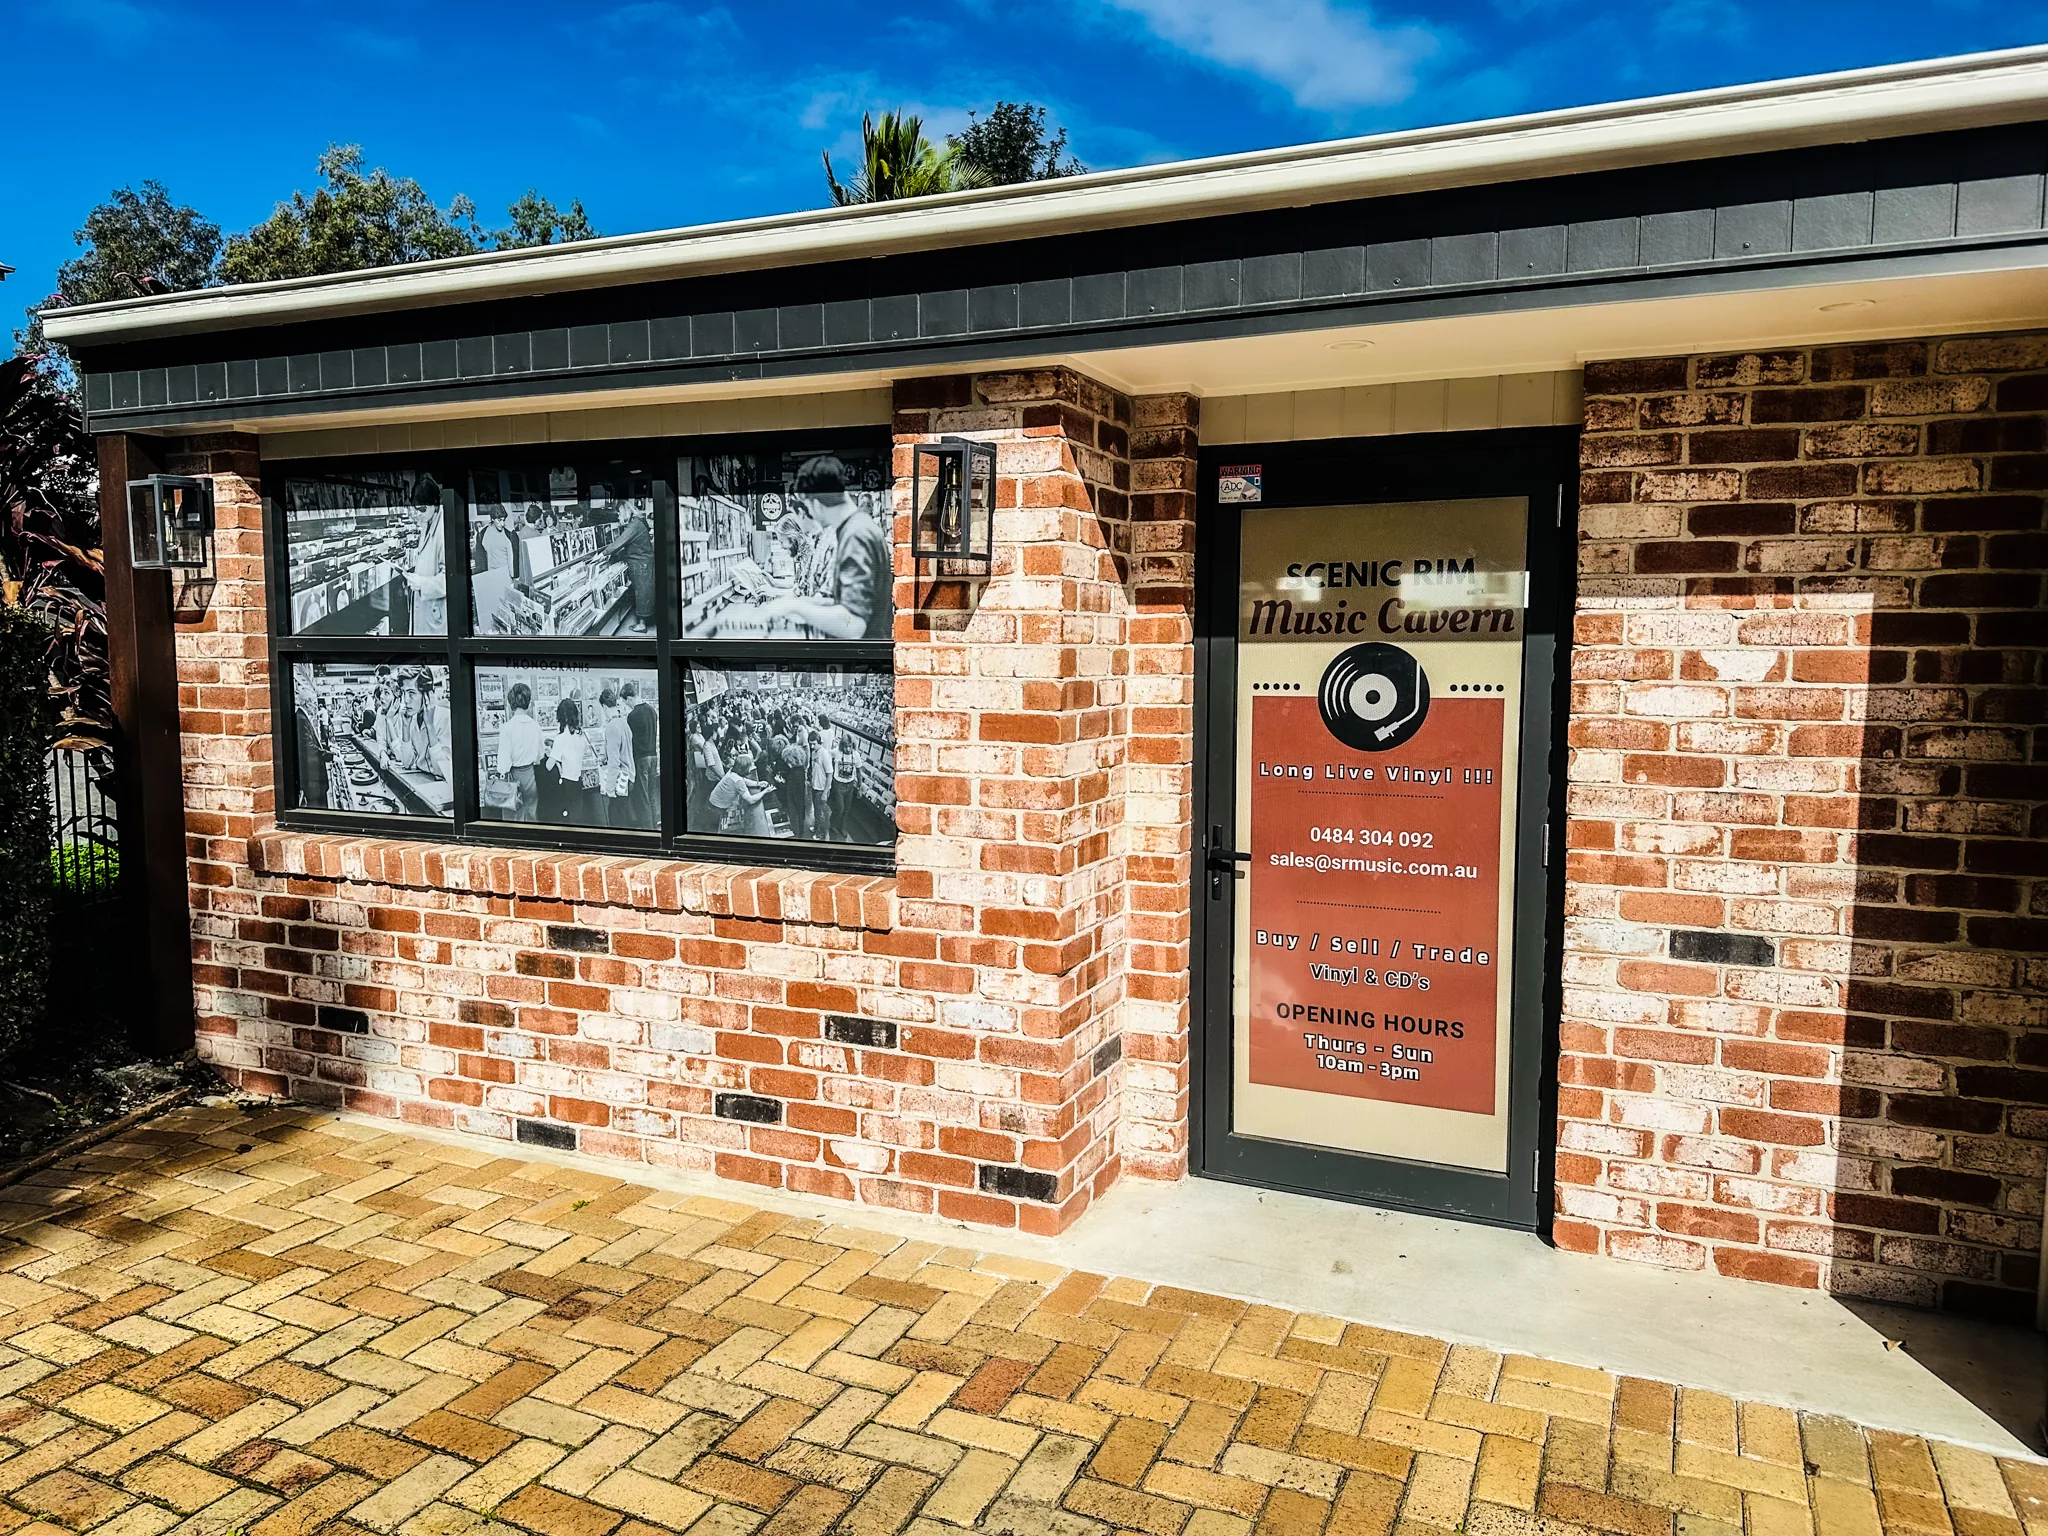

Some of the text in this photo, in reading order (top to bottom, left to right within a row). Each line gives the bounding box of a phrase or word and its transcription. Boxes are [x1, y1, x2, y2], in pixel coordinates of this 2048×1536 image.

[1221, 465, 1261, 476] WARNING
[1287, 558, 1476, 589] SCENIC RIM
[1249, 597, 1515, 635] Music Cavern
[505, 658, 590, 673] PHONOGRAPHS
[1259, 762, 1493, 785] Long Live Vinyl !!!
[1310, 827, 1434, 849] 0484 304 092
[1269, 851, 1478, 879] sales@srmusic.com.au
[1256, 930, 1490, 965] Buy / Sell / Trade
[1309, 963, 1358, 986] Vinyl
[1364, 969, 1380, 985] &
[1276, 1002, 1465, 1039] OPENING HOURS
[1303, 1032, 1366, 1055] Thurs
[1391, 1044, 1433, 1063] Sun
[1316, 1054, 1364, 1074] 10am
[1380, 1062, 1420, 1081] 3pm
